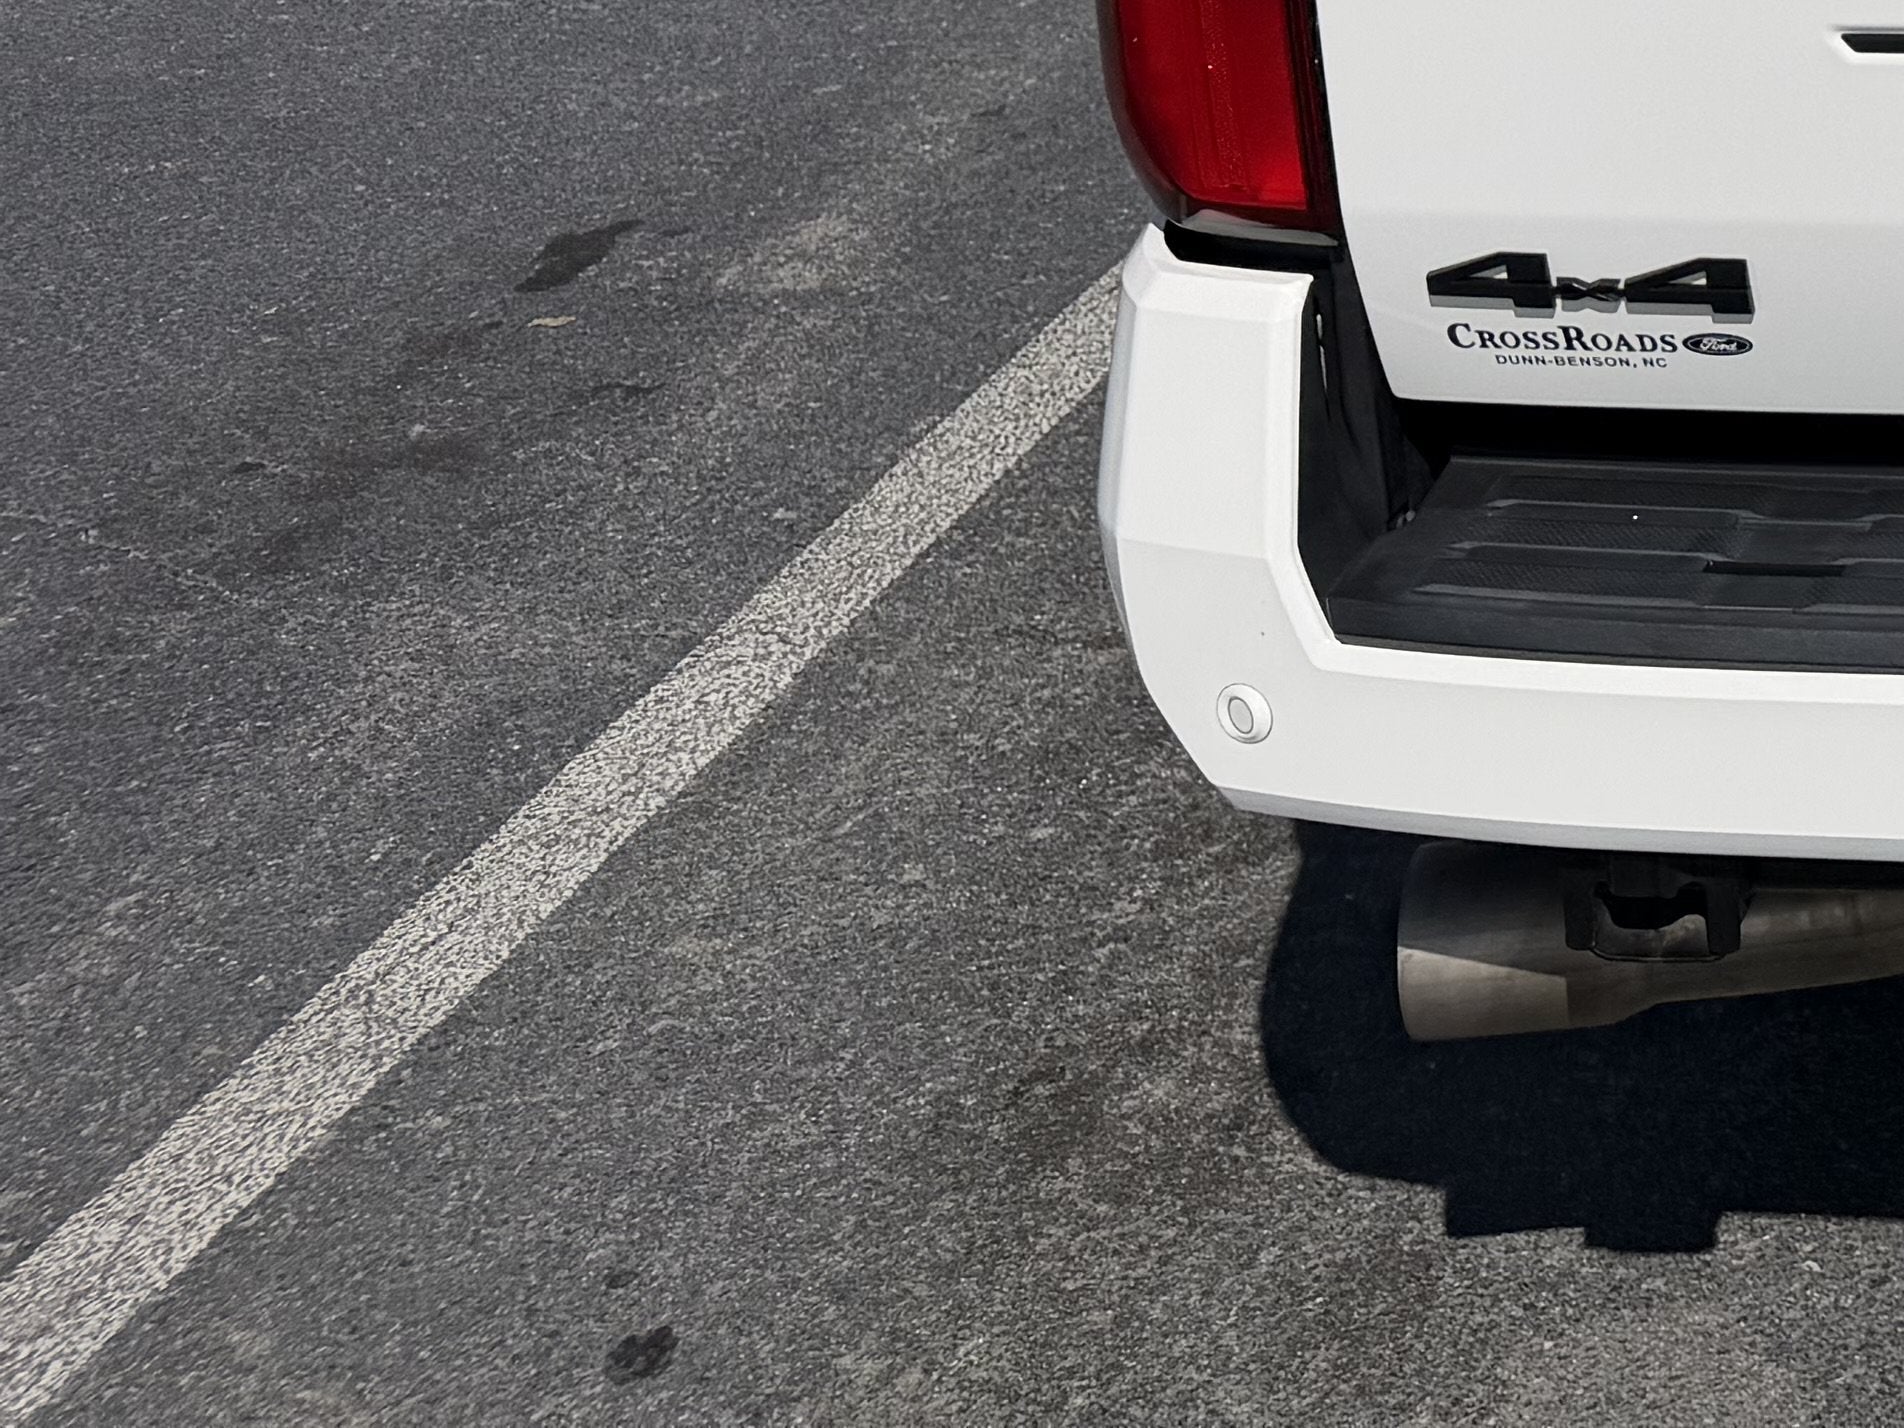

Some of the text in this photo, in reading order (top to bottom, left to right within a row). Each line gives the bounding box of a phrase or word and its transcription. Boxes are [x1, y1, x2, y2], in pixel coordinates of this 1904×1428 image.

[1699, 336, 1738, 352] Ford
[1495, 354, 1668, 369] DUNN-BENSON, NC
